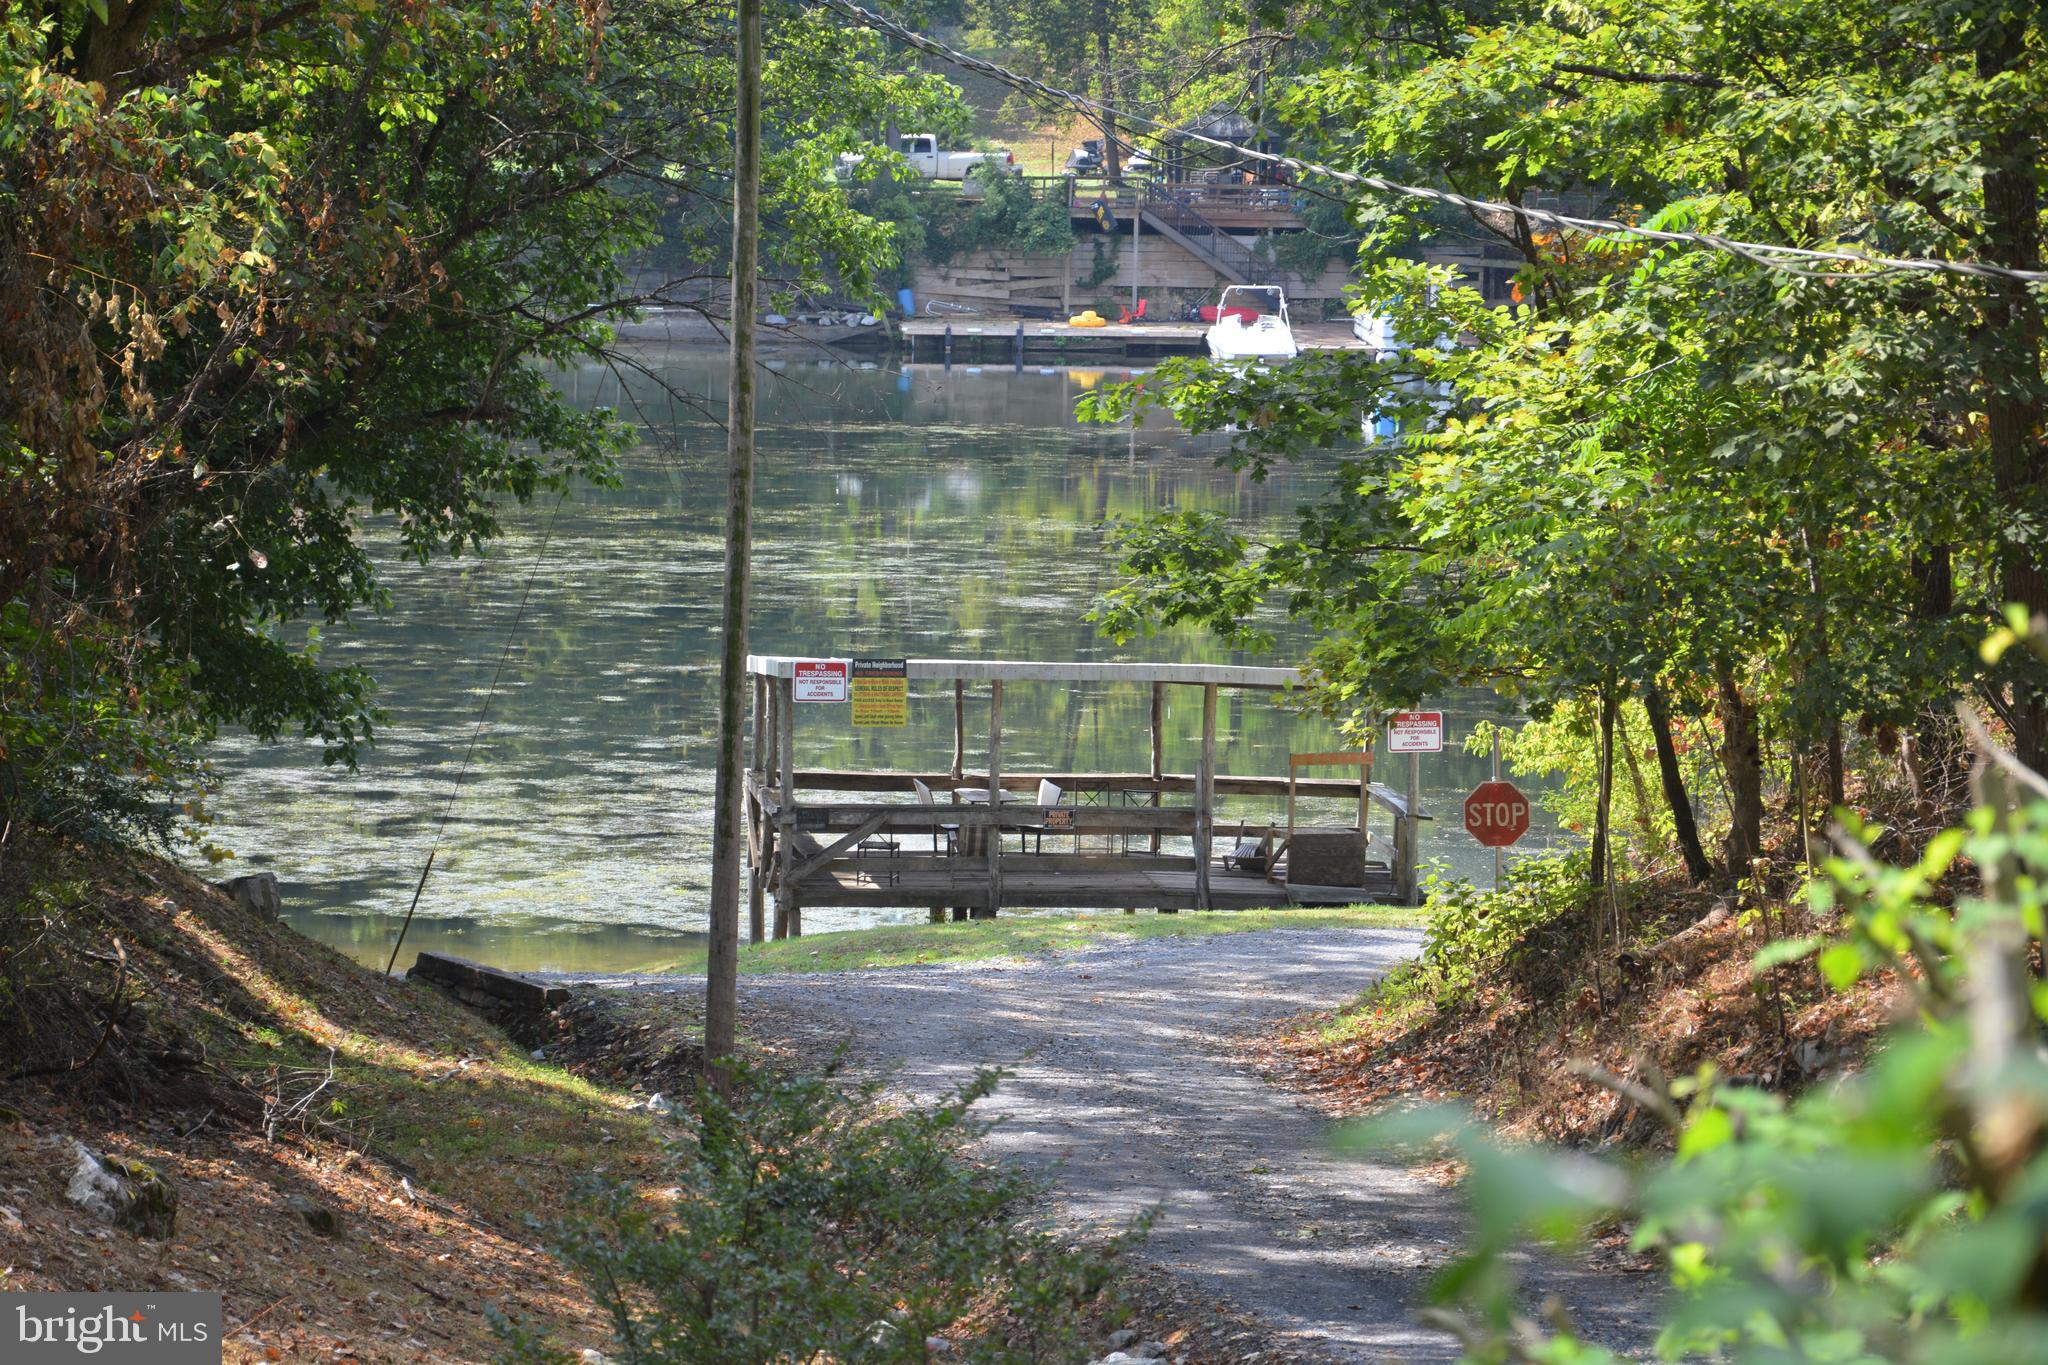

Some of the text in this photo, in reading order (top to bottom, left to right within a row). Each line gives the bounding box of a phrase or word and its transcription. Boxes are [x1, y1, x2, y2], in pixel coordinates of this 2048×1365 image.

[872, 660, 904, 670] Neighborhood
[1469, 802, 1526, 827] STOP
[1044, 817, 1073, 825] PROPERTY
